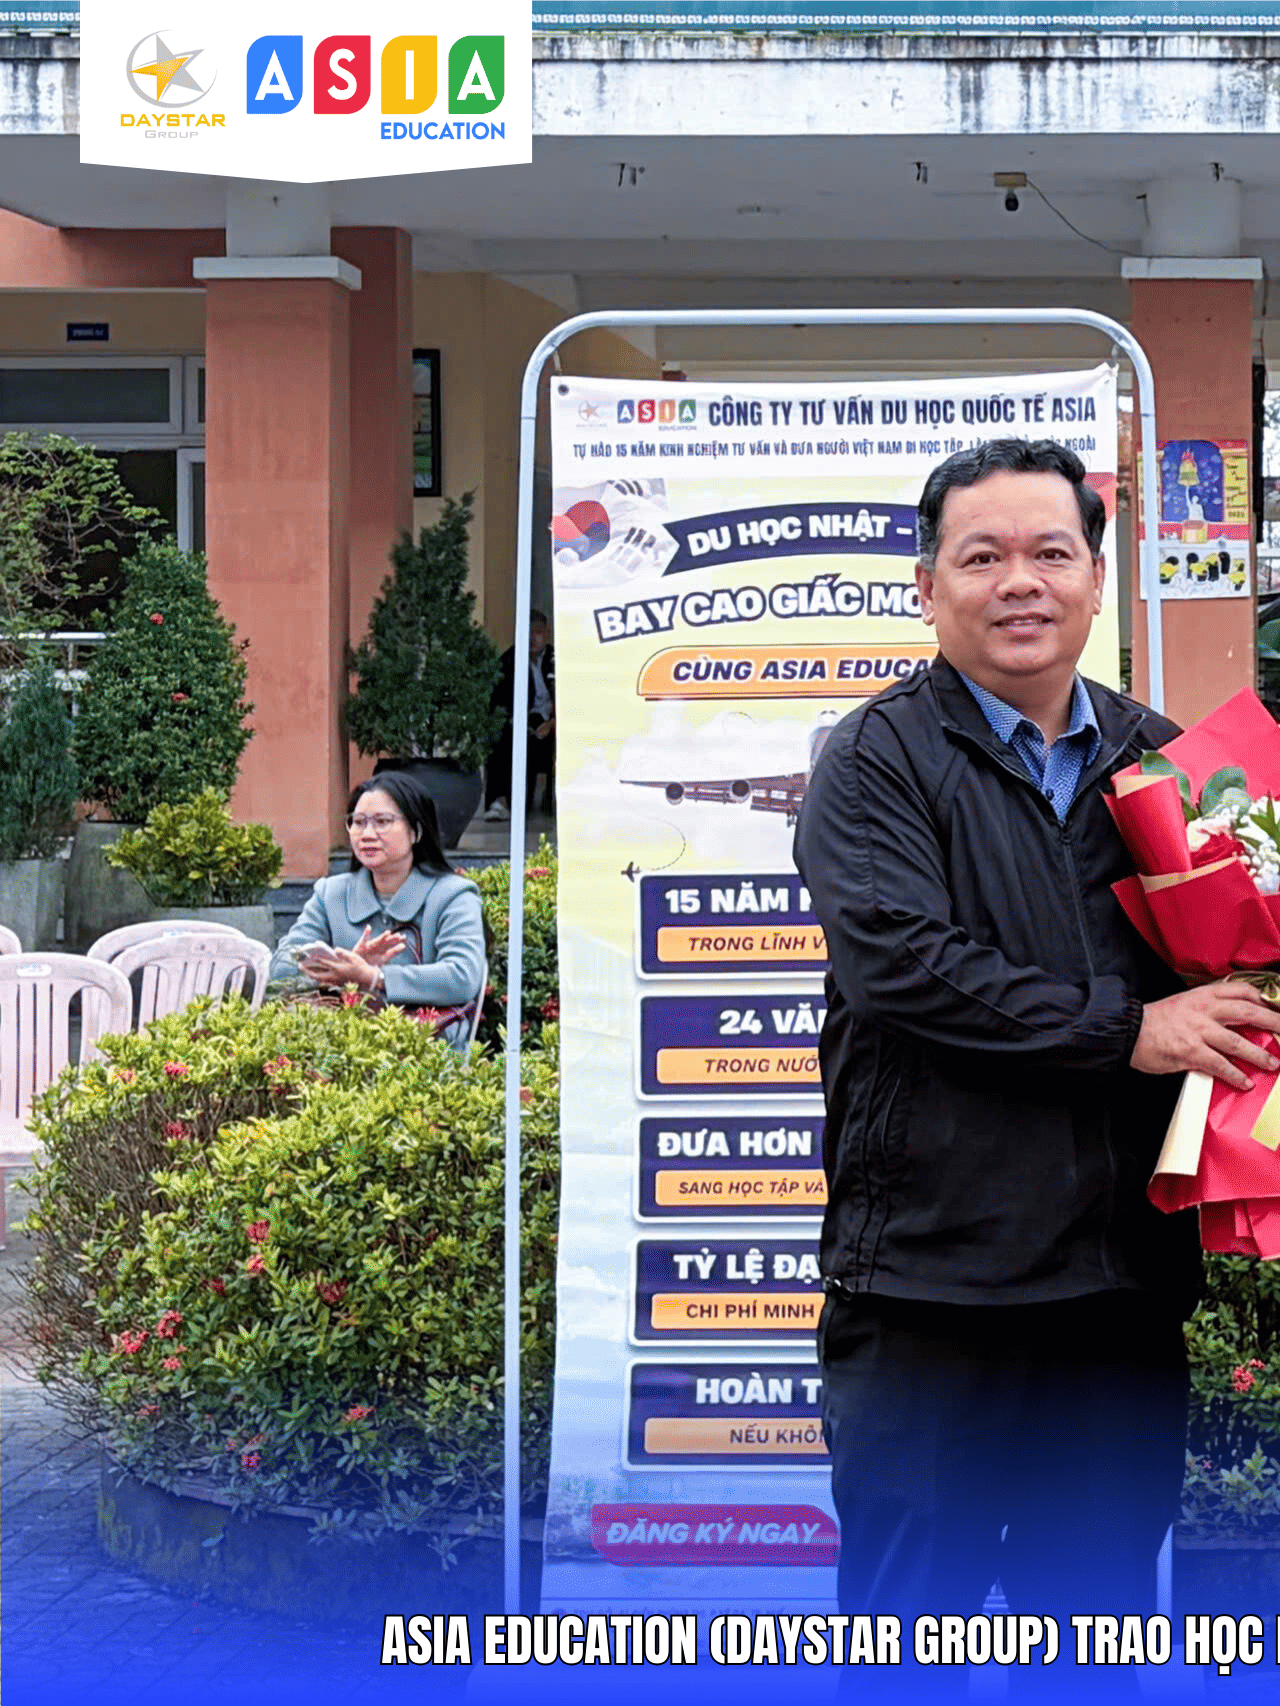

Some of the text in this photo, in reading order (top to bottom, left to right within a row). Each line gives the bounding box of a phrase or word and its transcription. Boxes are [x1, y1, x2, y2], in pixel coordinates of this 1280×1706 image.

[617, 401, 696, 423] ASIA
[708, 392, 1097, 430] CÔNG TY TƯ VẤN DU HỌC QUỐC TẾ ASIA
[573, 443, 587, 460] TỰ
[616, 443, 627, 457] 15
[630, 440, 656, 457] NĂM
[659, 443, 684, 457] KINH
[687, 440, 729, 460] NGHIỆM
[732, 441, 746, 456] TƯ
[749, 440, 771, 456] VẤN
[773, 439, 788, 456] VÀ
[790, 441, 813, 456] ĐƯA
[816, 438, 849, 456] NGƯỜI
[852, 438, 874, 457] VIỆT
[877, 440, 903, 455] NAM
[919, 440, 941, 457] HỌC
[687, 524, 733, 557] DU
[737, 516, 802, 547] HỌC
[808, 508, 891, 542] NHẬT
[594, 595, 680, 644] BAY
[680, 586, 767, 627] CAO
[768, 573, 866, 617] GIẤC
[673, 656, 752, 682] CÙNG
[760, 660, 827, 680] ASIA
[664, 889, 701, 914] 15
[710, 881, 790, 913] NĂM
[689, 937, 754, 951] TRONG
[760, 932, 806, 951] LĨNH
[719, 1009, 763, 1035] 24
[704, 1058, 770, 1073] TRONG
[657, 1127, 812, 1157] ĐƯA HƠN
[678, 1181, 723, 1194] SANG
[728, 1181, 764, 1197] HỌC
[770, 1178, 800, 1197] TẬP
[726, 1248, 764, 1284] LỆ
[686, 1299, 815, 1319] CHI PHÍ MINH
[696, 1371, 793, 1404] HOÀN
[730, 1423, 769, 1443] NẾU
[606, 1516, 820, 1544] ĐĂNG KÝ NGAY
